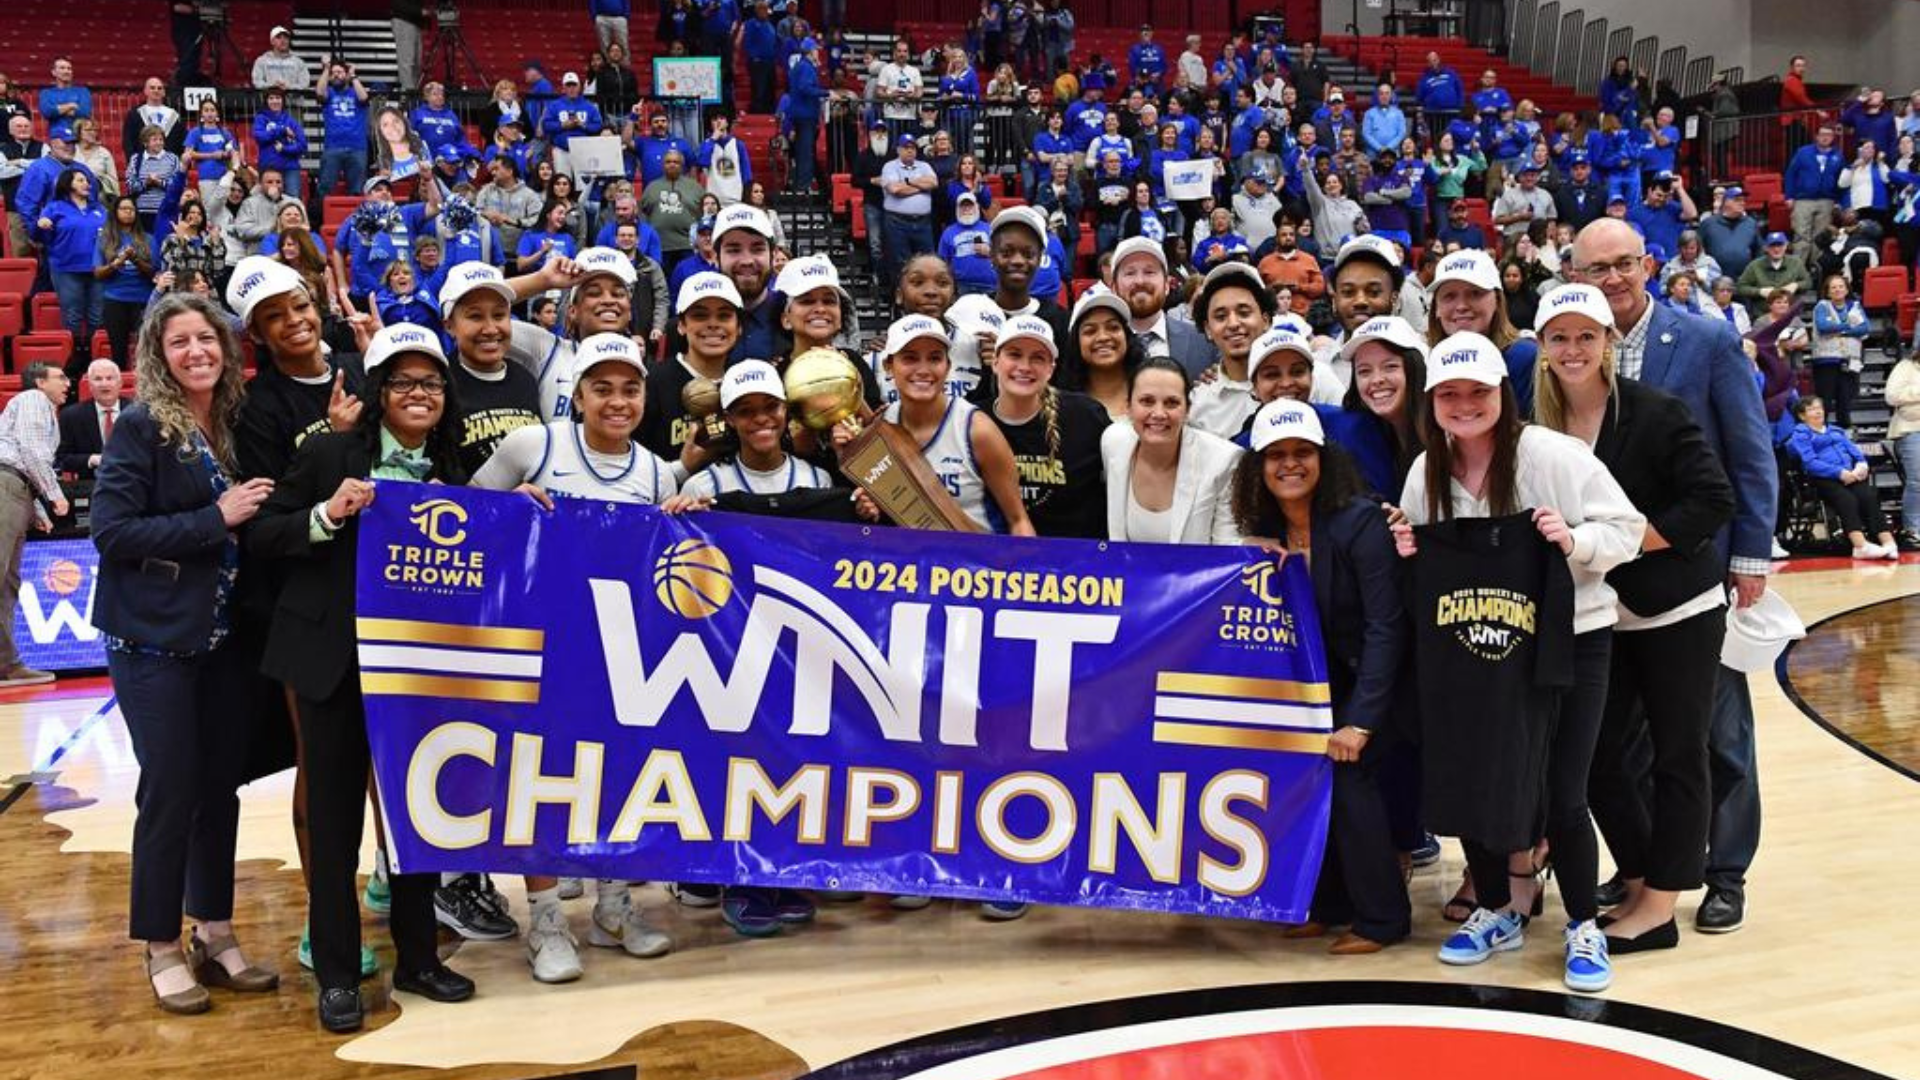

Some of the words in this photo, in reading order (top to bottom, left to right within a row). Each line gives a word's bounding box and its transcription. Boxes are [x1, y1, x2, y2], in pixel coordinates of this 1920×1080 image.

[587, 253, 617, 264] WNIT
[1444, 258, 1477, 272] WNIT
[237, 270, 267, 299] WNIT
[464, 268, 495, 281] WNIT
[1551, 290, 1589, 306] WNIT
[391, 330, 426, 347] WNIT
[595, 340, 629, 354] WNIT
[1441, 348, 1479, 366] WNIT
[735, 369, 766, 385] WNIT
[1270, 411, 1304, 427] WNIT
[864, 454, 893, 485] WNIT
[1015, 459, 1067, 485] PIONS
[387, 545, 485, 569] TRIPLE
[384, 564, 484, 588] CROWN
[833, 558, 918, 594] 2024
[929, 564, 1124, 607] POSTSEASON
[1438, 595, 1535, 634] CHAMPONS
[1467, 624, 1511, 647] WNT
[588, 565, 1122, 752] WNIT
[406, 721, 1270, 898] CHAMPIONS
